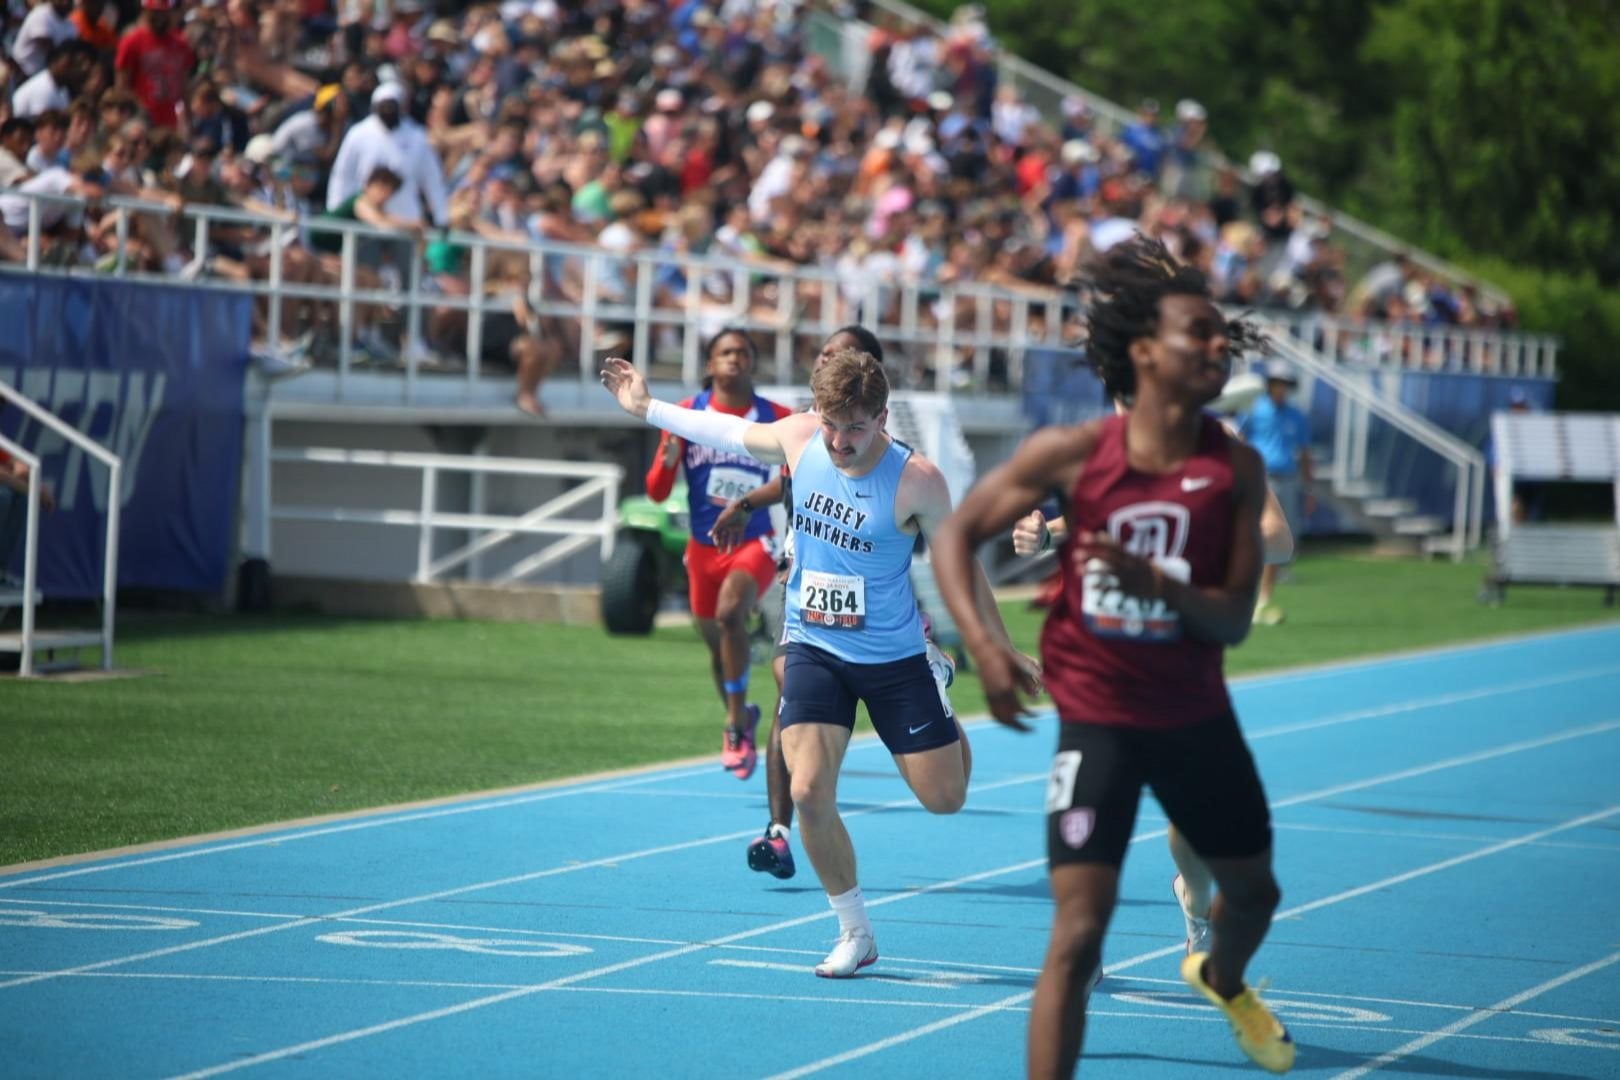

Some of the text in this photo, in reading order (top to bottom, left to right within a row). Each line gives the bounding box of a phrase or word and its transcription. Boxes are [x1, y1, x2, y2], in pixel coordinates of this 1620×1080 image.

[804, 491, 867, 531] JERSEY
[795, 513, 874, 553] PANTHERS
[806, 585, 859, 613] 2364
